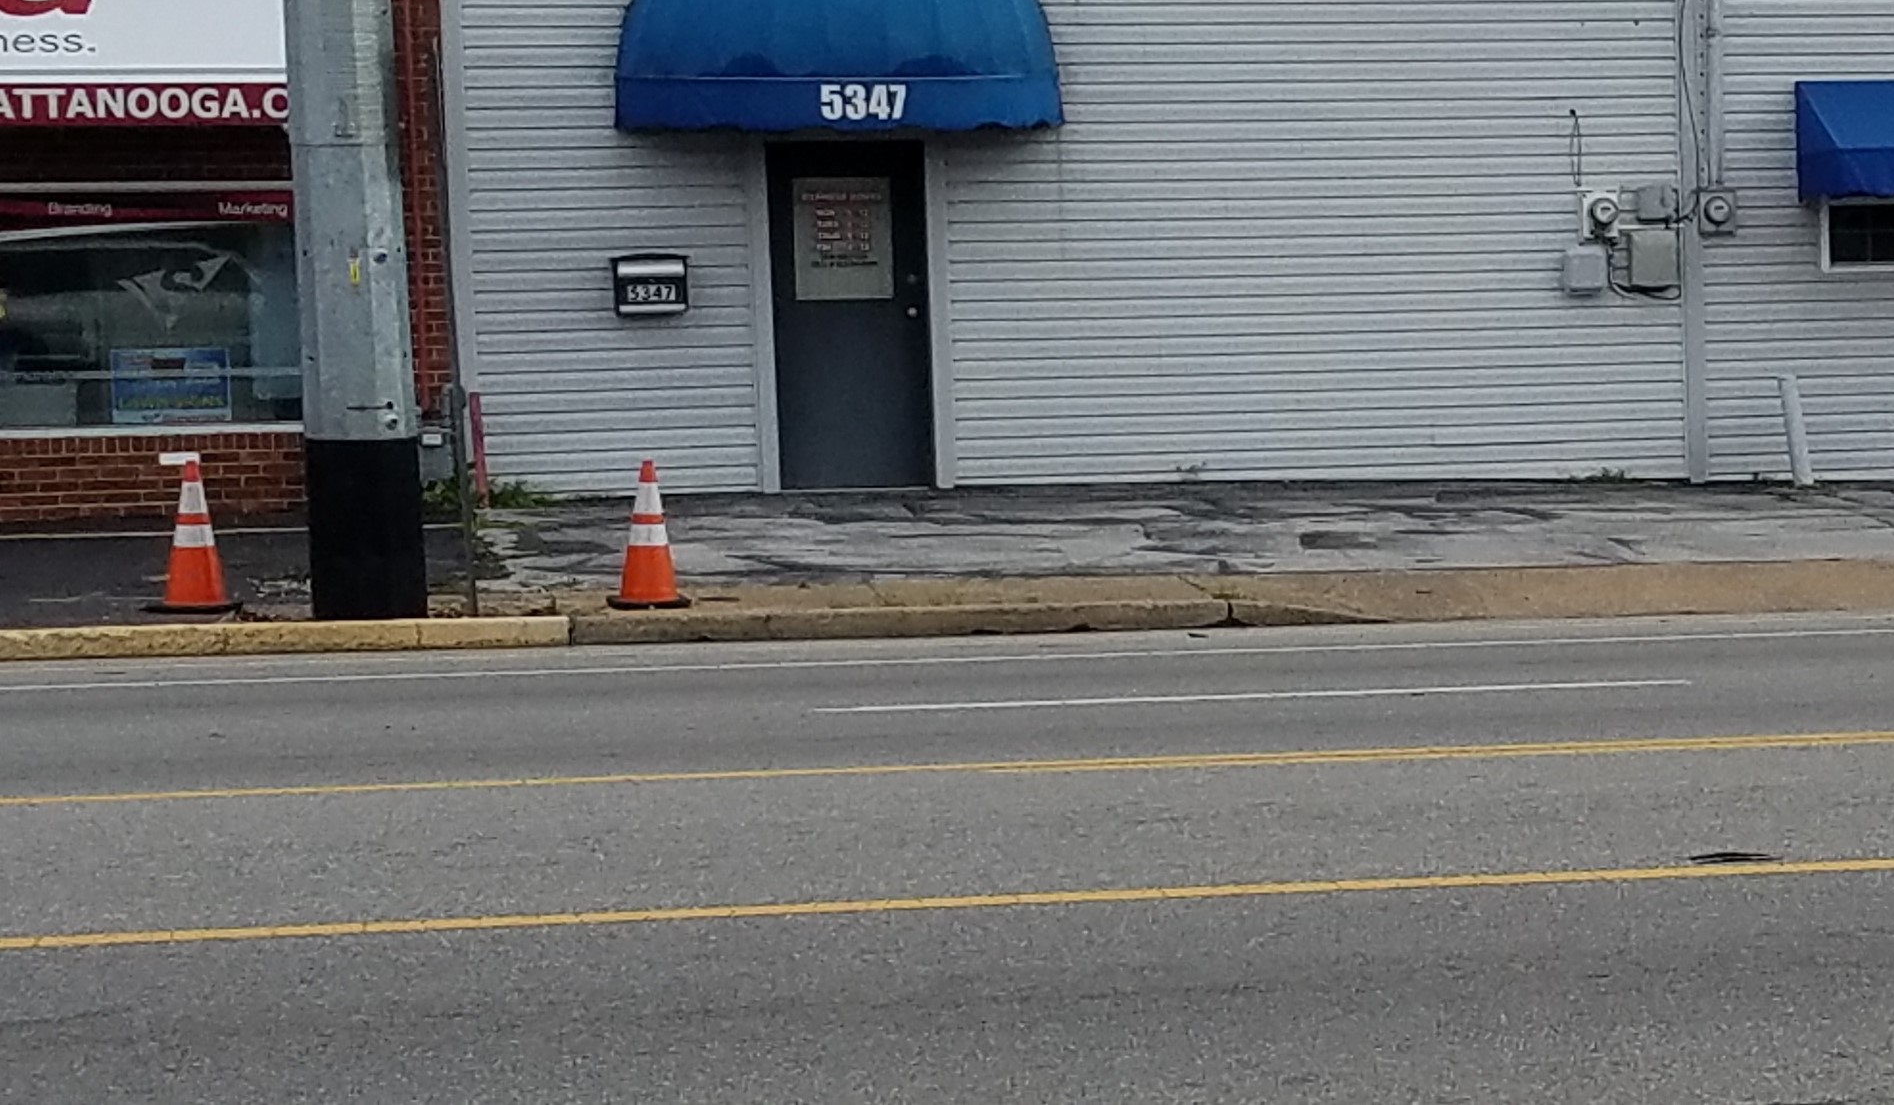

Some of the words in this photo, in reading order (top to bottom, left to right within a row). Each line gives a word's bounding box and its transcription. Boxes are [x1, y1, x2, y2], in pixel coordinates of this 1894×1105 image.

[820, 83, 907, 120] 5347
[48, 202, 113, 217] Branding
[218, 201, 289, 217] Marketing
[628, 285, 675, 300] 5347
